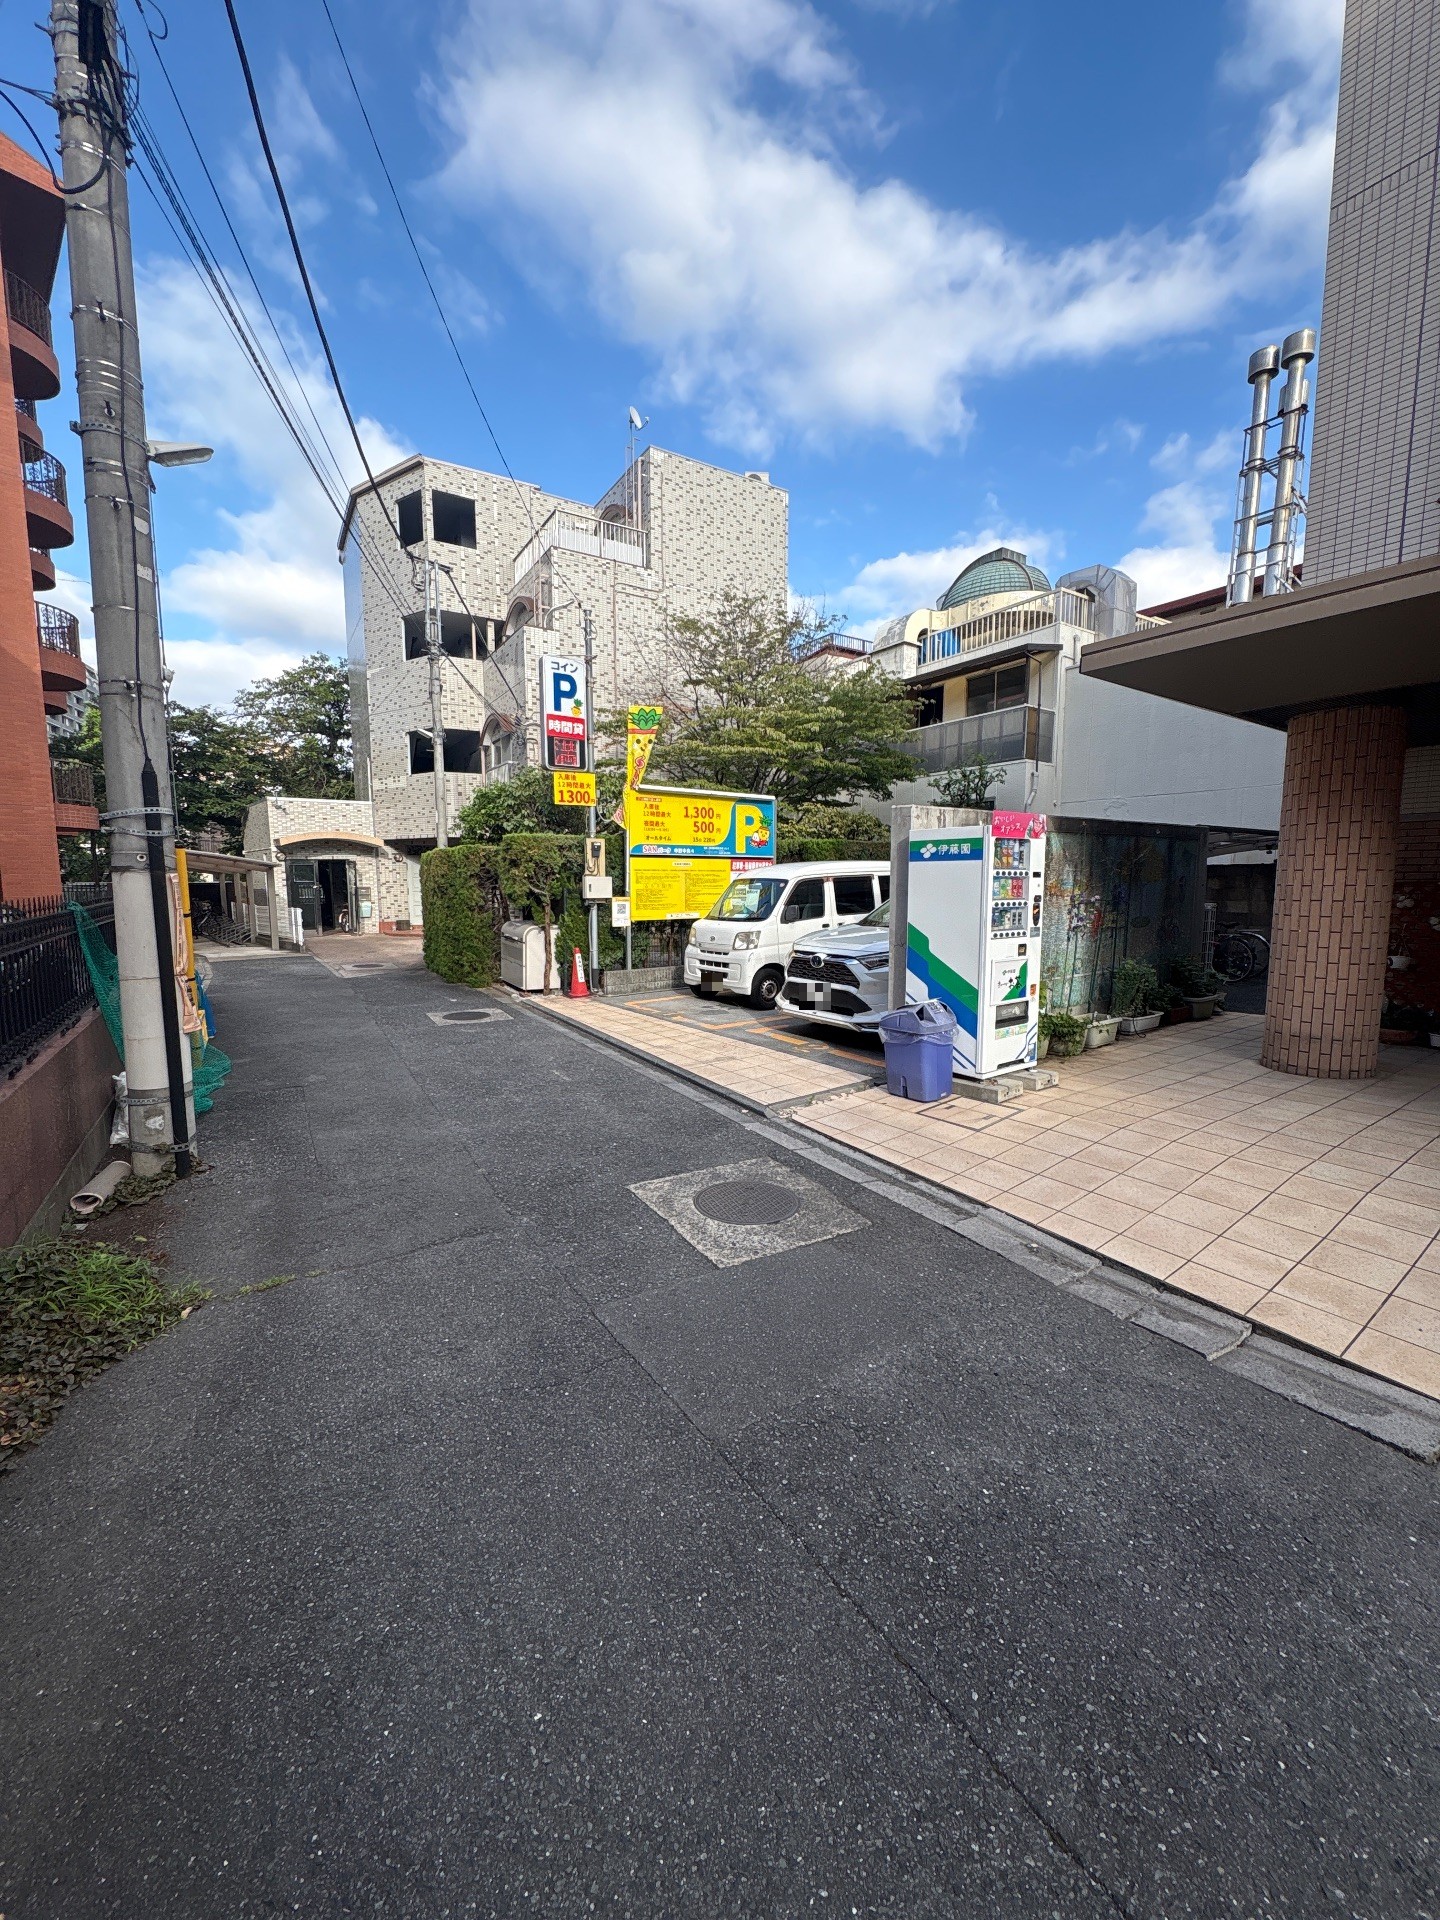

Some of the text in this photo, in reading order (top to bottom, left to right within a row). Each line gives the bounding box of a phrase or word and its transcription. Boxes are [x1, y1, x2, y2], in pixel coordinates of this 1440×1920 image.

[551, 661, 578, 673] コイン
[553, 672, 577, 712] P
[549, 720, 584, 735] 時間貸
[994, 815, 1015, 825] おいしい
[736, 804, 764, 853] P
[938, 843, 971, 855] 伊藤園
